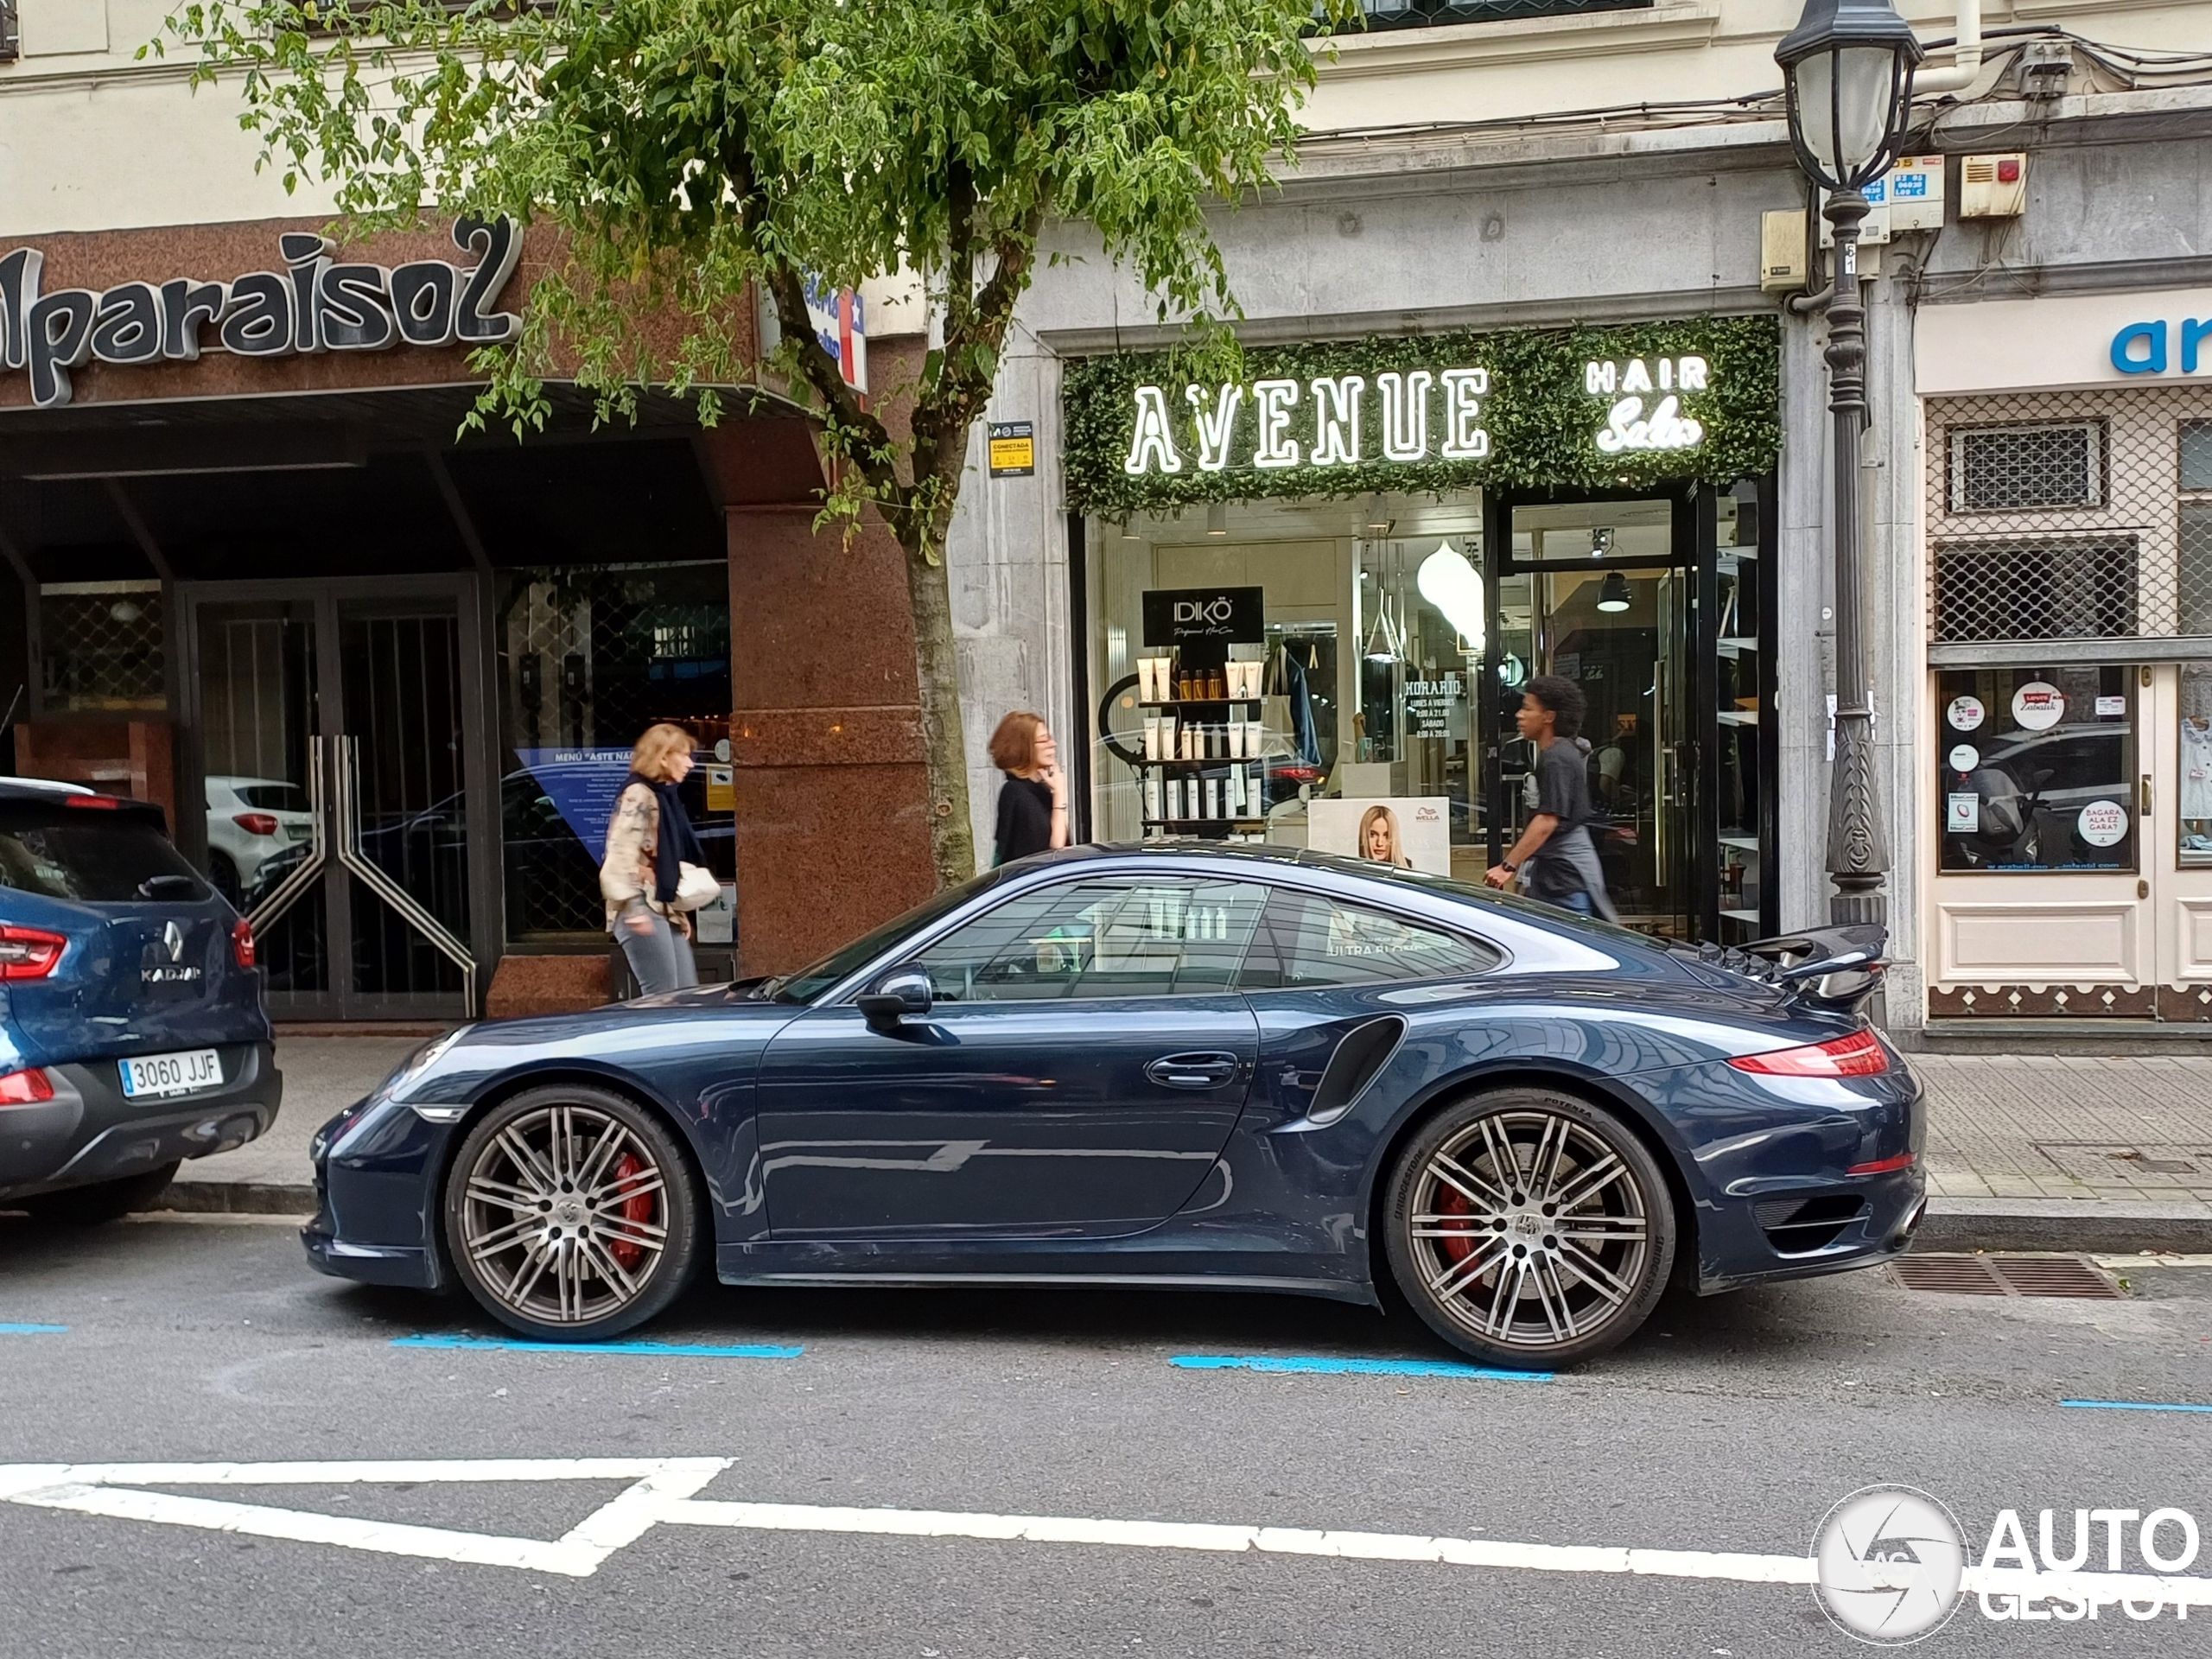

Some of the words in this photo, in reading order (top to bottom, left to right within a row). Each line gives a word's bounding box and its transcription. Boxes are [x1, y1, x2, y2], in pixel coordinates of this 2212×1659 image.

[1586, 356, 1708, 394] HAIR
[1125, 367, 1488, 474] AVENUE
[1404, 680, 1461, 696] HORARIO
[555, 752, 582, 762] MENÚ
[134, 1059, 181, 1088] 3060
[188, 1055, 214, 1081] JJF
[1544, 1096, 1592, 1118] POTENZA
[1394, 1147, 1426, 1221] BRIDGESTONE
[1634, 1235, 1664, 1310] BRIDGESTONE
